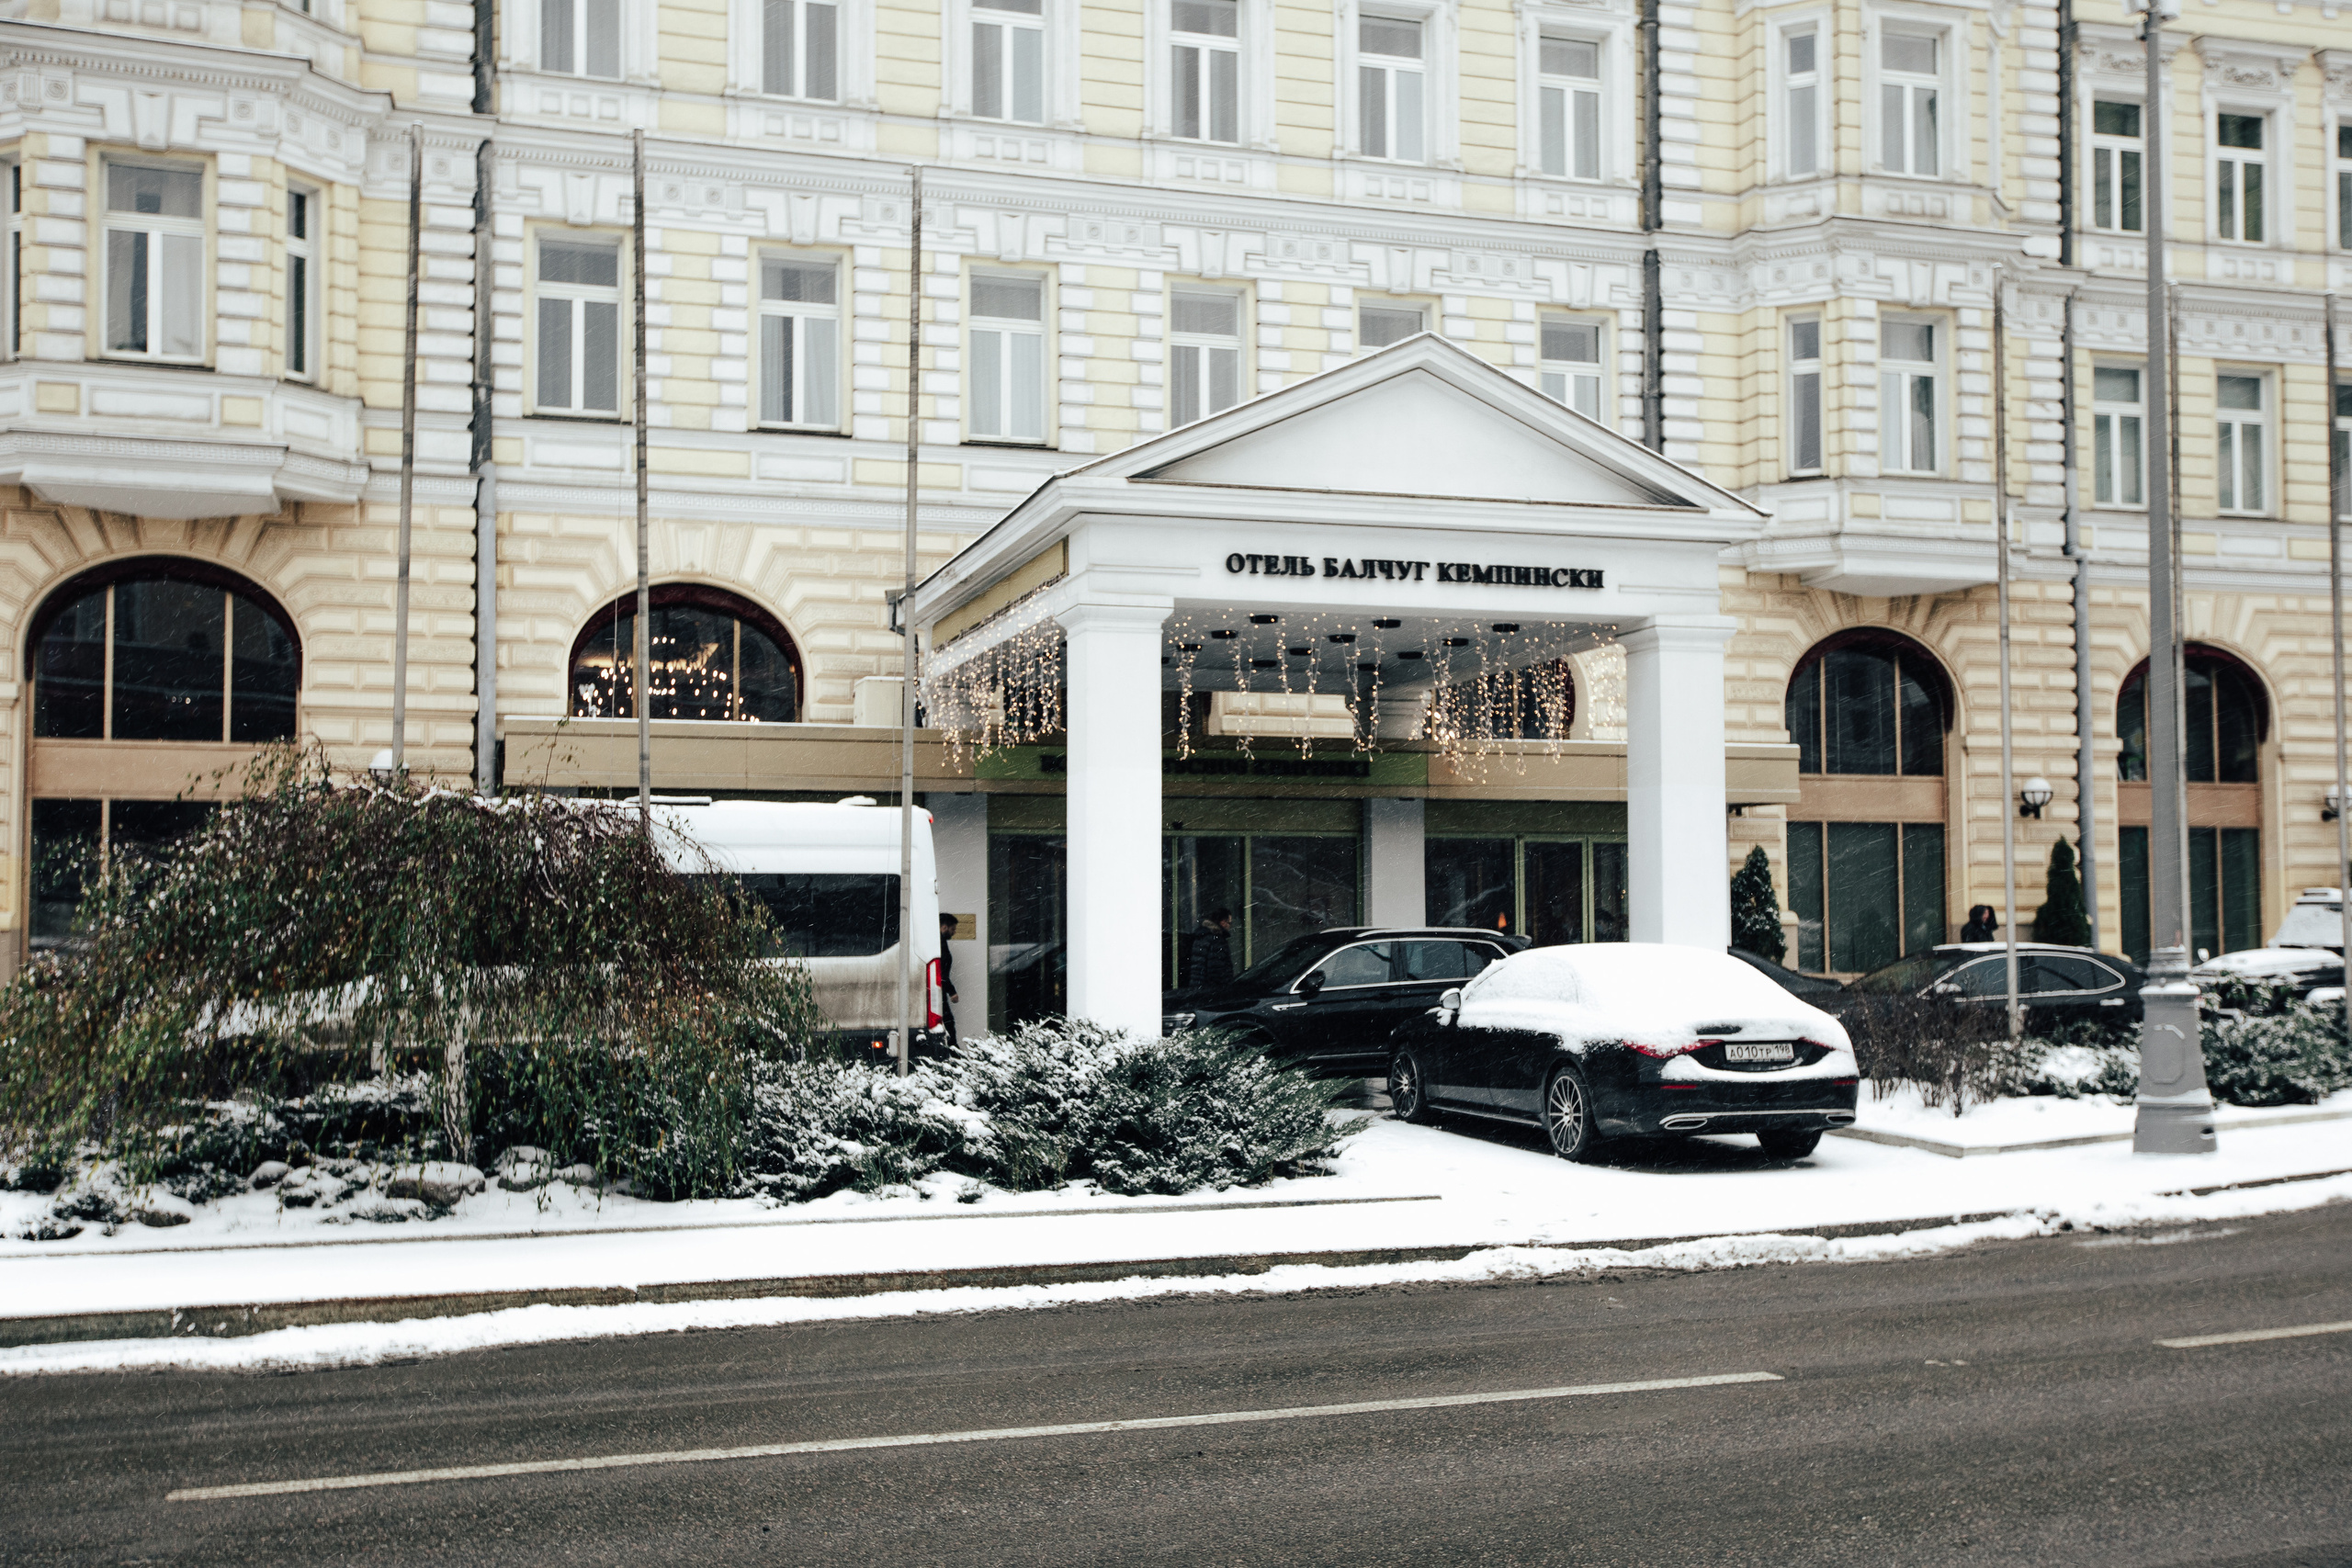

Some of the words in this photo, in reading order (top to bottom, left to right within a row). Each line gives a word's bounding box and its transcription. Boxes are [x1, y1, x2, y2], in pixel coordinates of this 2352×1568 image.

[1226, 553, 1315, 577] ОТЕЛЬ
[1323, 557, 1430, 581] БАЛЧУГ
[1437, 562, 1605, 589] КЕМПИНСКИ
